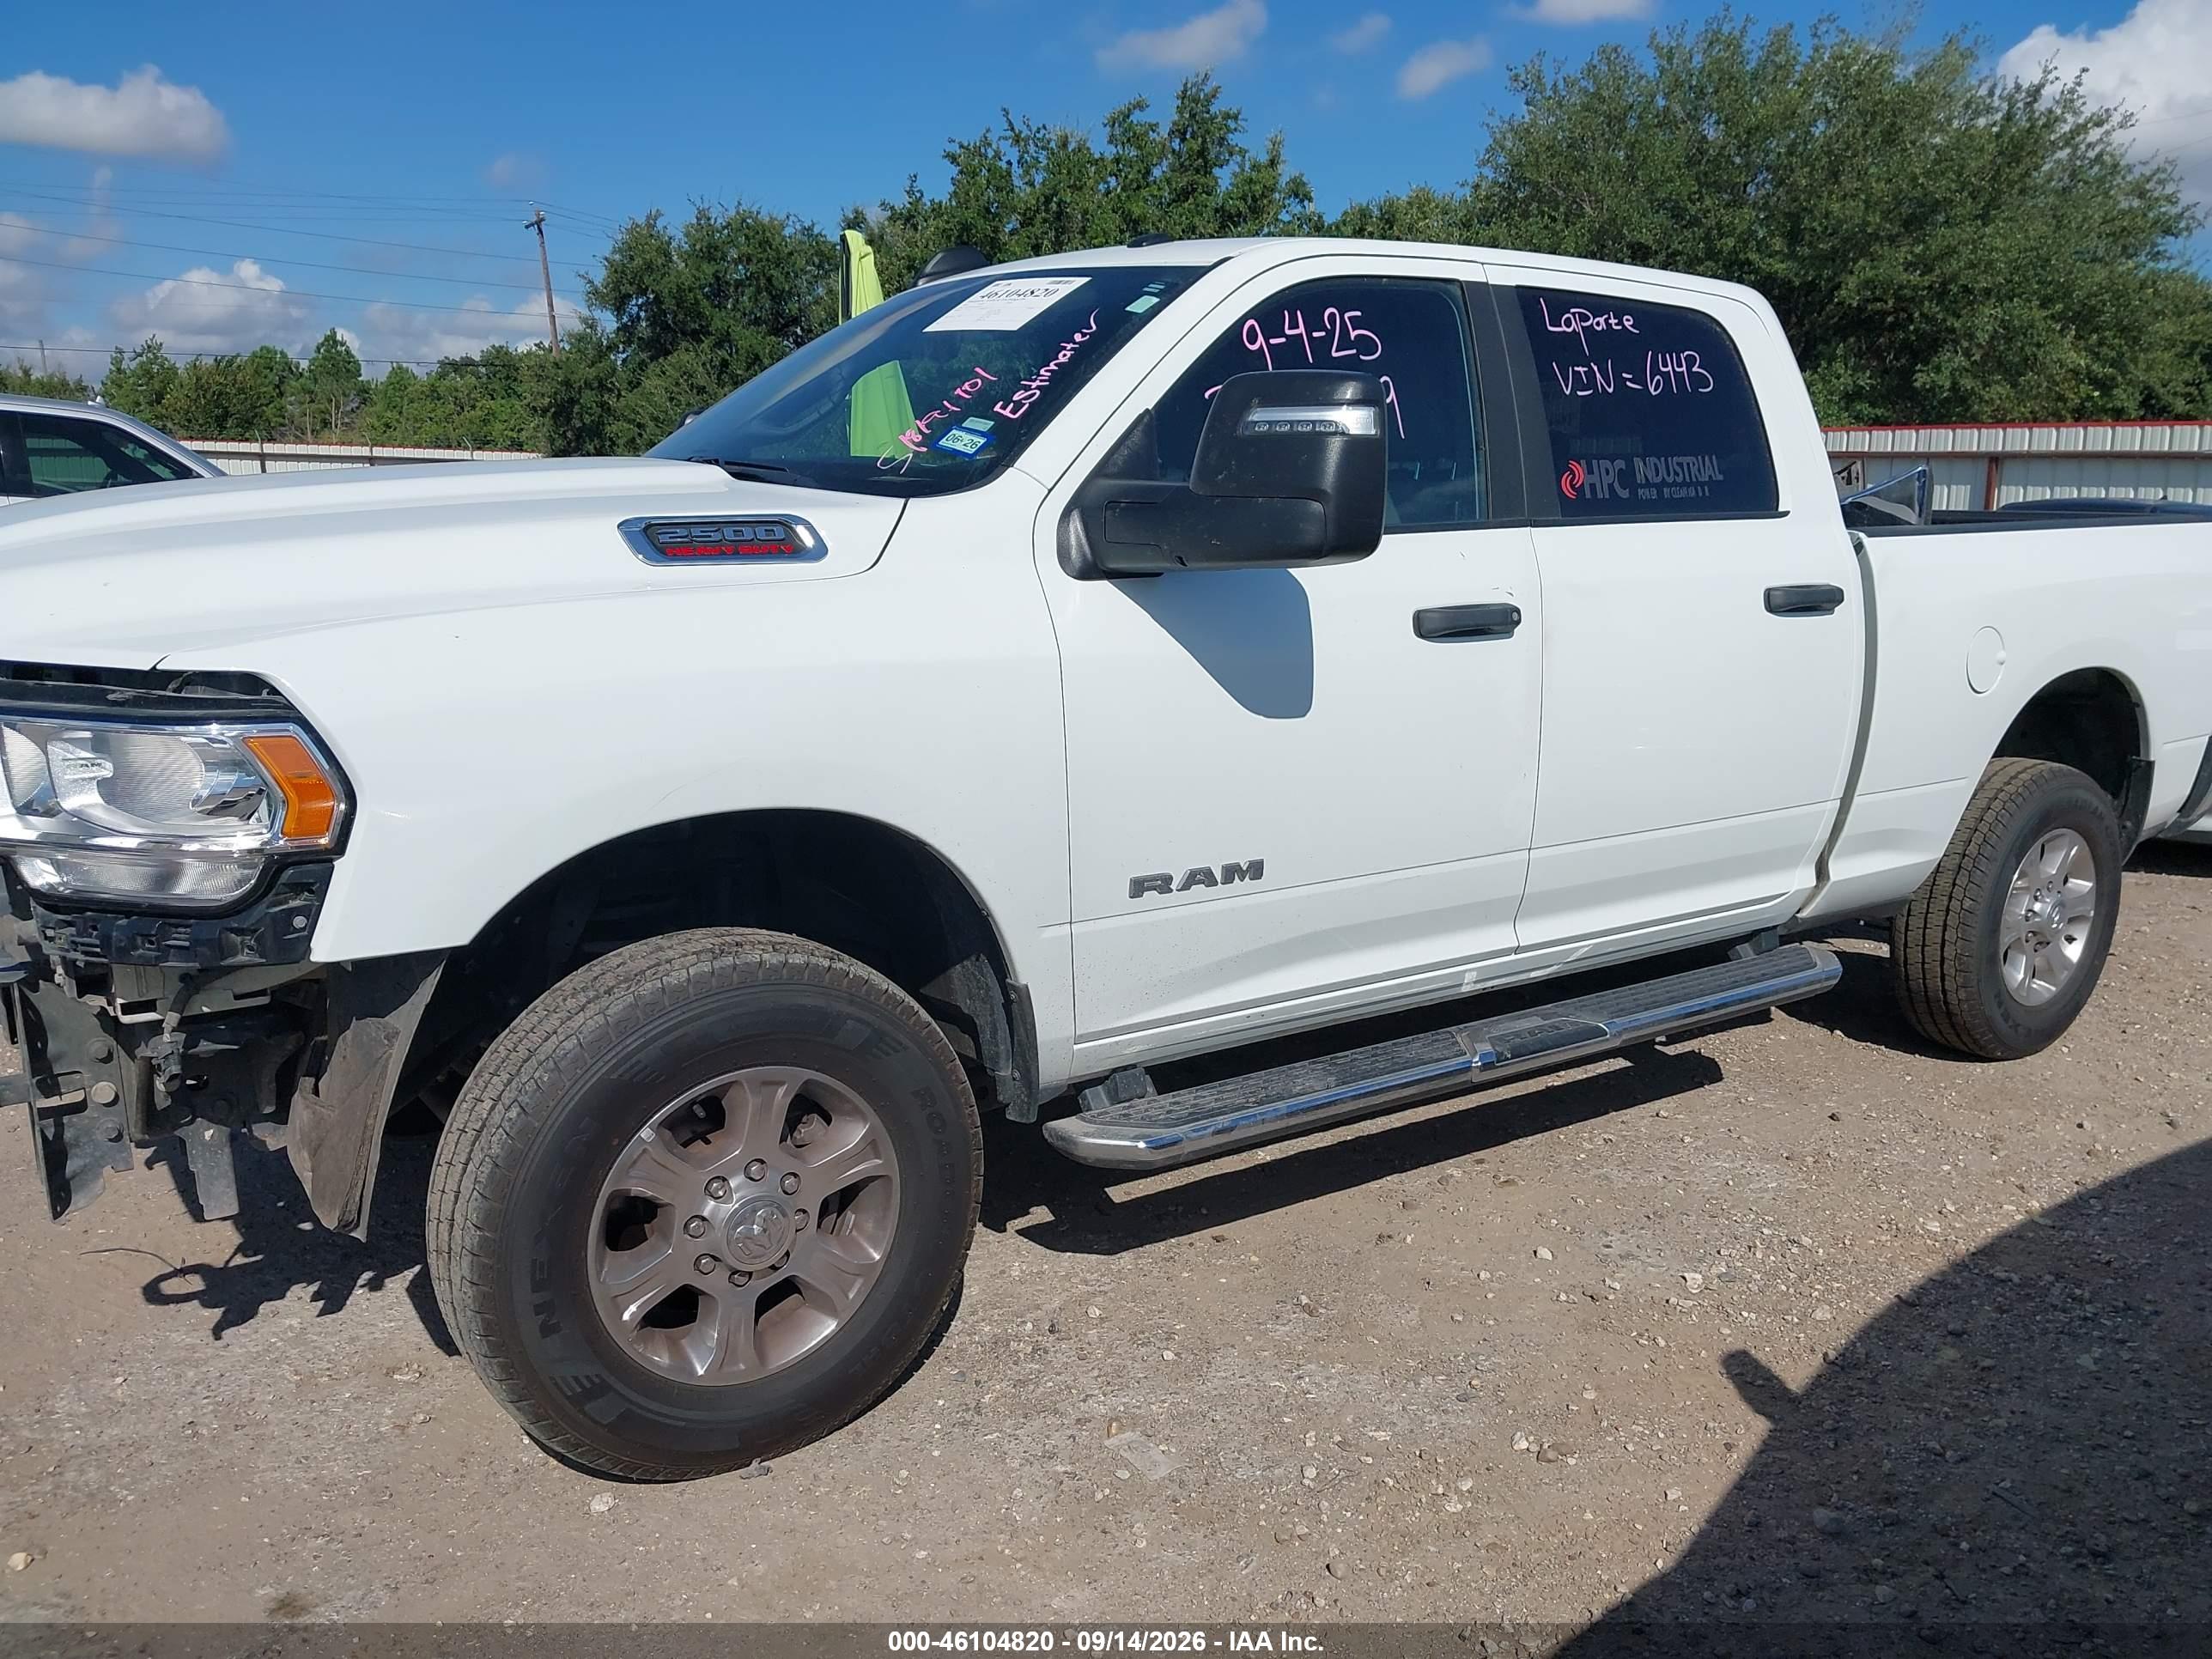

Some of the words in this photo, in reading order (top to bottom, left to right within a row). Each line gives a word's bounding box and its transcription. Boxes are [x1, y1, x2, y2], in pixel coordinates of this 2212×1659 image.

[1580, 459, 1630, 498] HPC
[1633, 454, 1724, 483] INDUSTRIAL
[656, 526, 786, 544] 2500
[665, 544, 735, 557] HEAVY
[738, 543, 794, 556] DUTY
[1128, 858, 1264, 899] RAM
